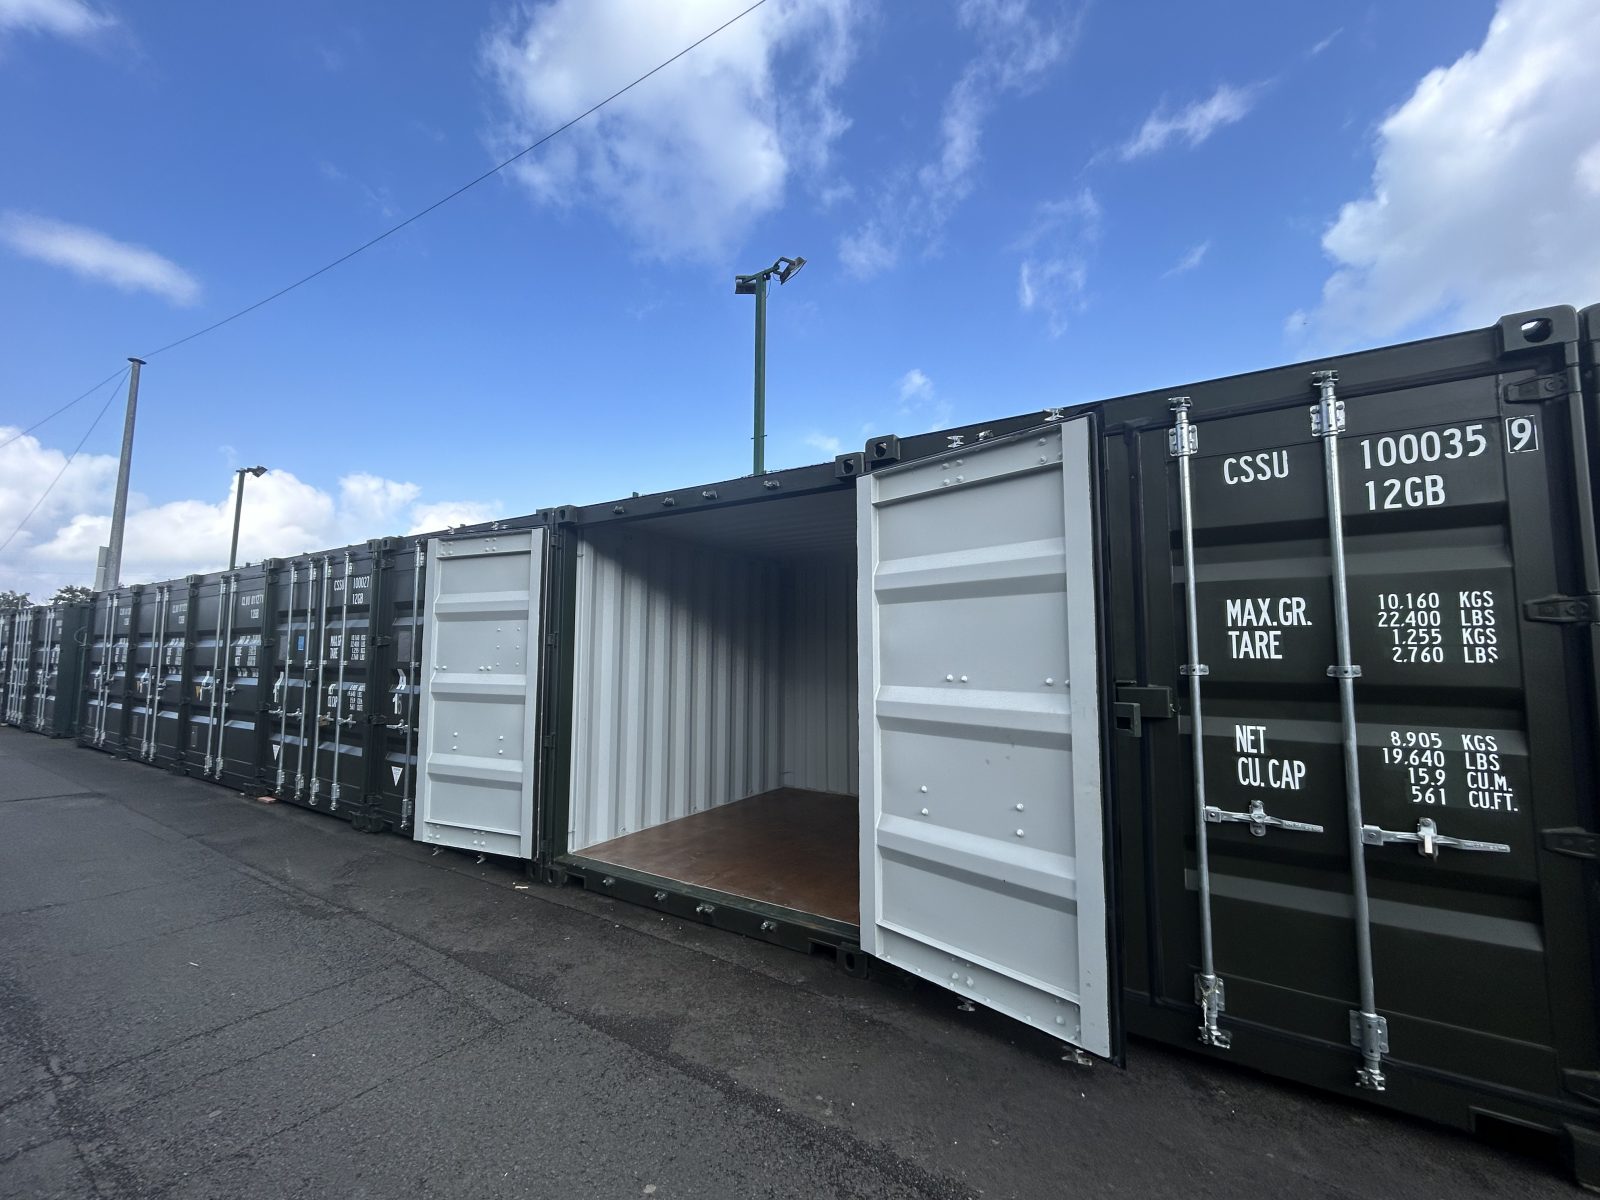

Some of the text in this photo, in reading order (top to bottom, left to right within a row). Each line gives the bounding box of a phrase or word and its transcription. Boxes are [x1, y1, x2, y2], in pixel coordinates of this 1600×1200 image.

[1223, 418, 1532, 485] CSSU 100035 9
[1365, 474, 1446, 511] 12GB
[1226, 590, 1494, 627] MAX.GR. 10,160 KGS
[1377, 608, 1496, 628] 22,400 LBS
[1227, 627, 1498, 660] TARE 1,255 KGS
[1391, 646, 1499, 664] 2,760 LBS
[1235, 724, 1267, 754] NET
[1460, 733, 1498, 752] KGS
[1464, 751, 1501, 771] LBS
[1408, 766, 1446, 786] 15.9
[1466, 771, 1513, 792] CU.M.
[1411, 785, 1519, 812] 561 CU.FT.
